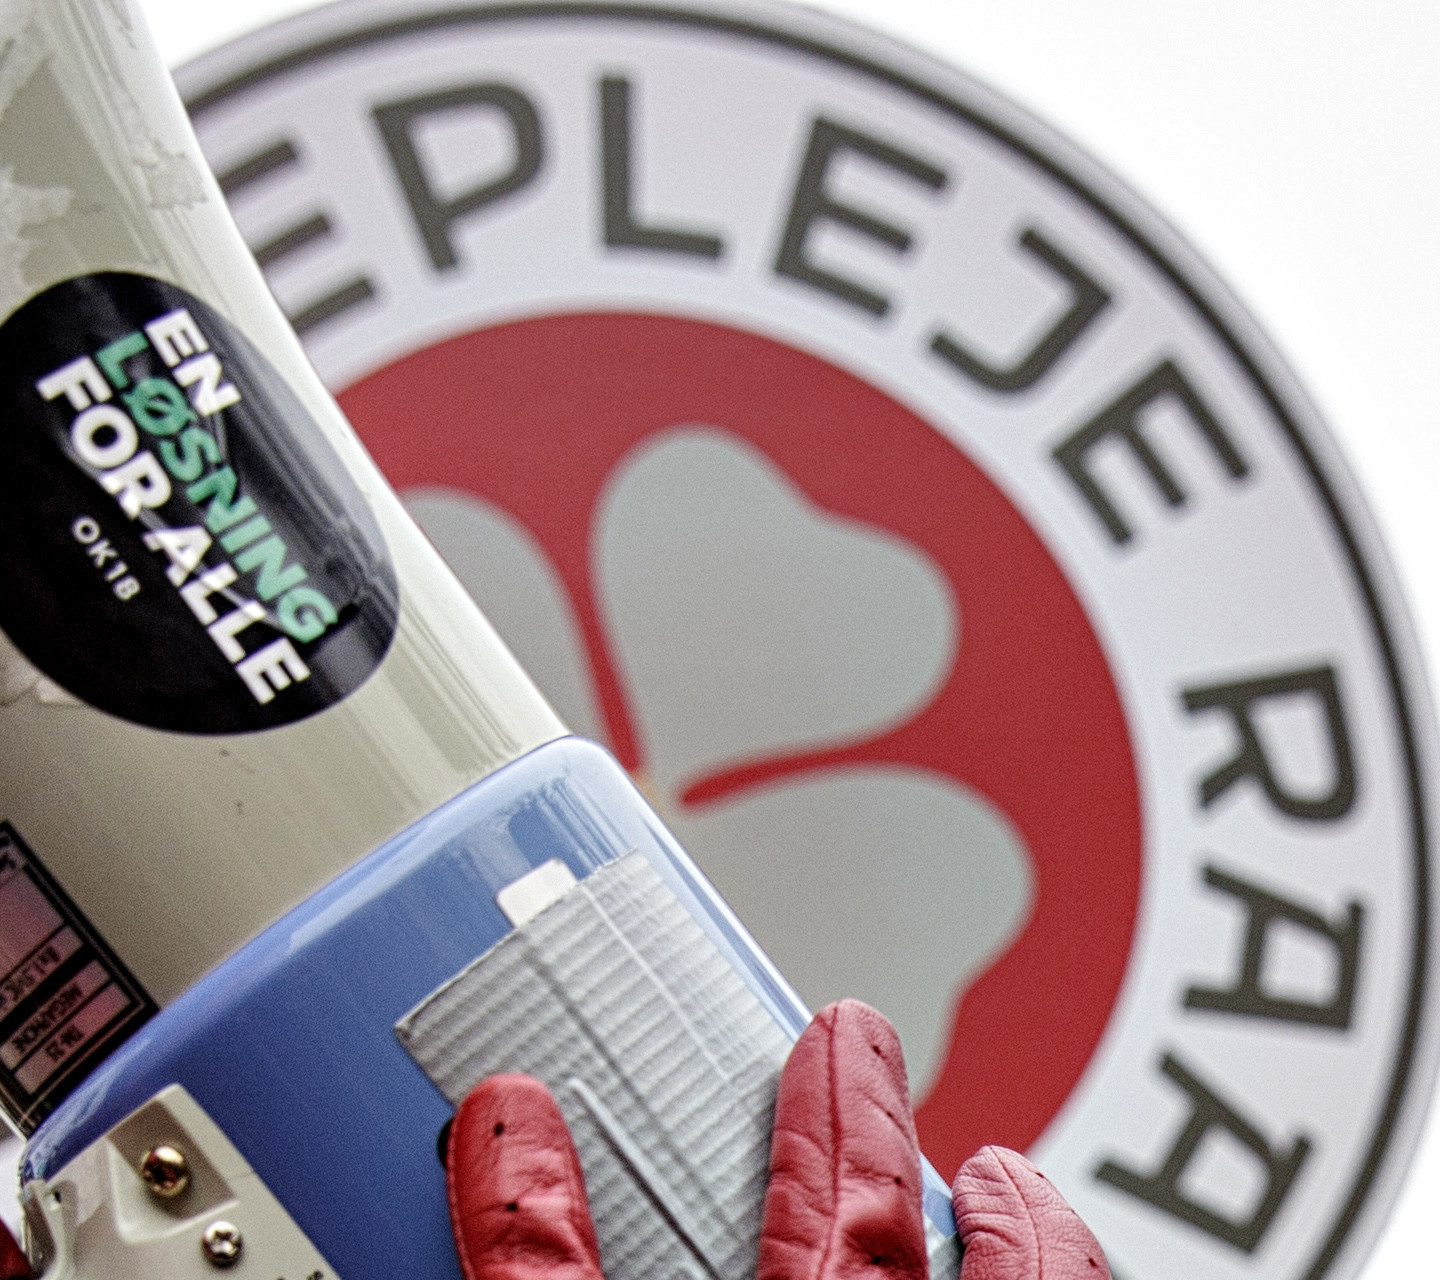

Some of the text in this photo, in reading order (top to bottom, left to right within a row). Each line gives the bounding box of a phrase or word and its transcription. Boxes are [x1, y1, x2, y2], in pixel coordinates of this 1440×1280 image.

[145, 308, 241, 417] EN
[220, 72, 1252, 550] EPLEJE
[36, 355, 311, 704] FOR ALLE
[72, 517, 141, 600] OK18
[95, 331, 338, 644] LØSNING
[9, 982, 86, 1055] MEGAPHONE
